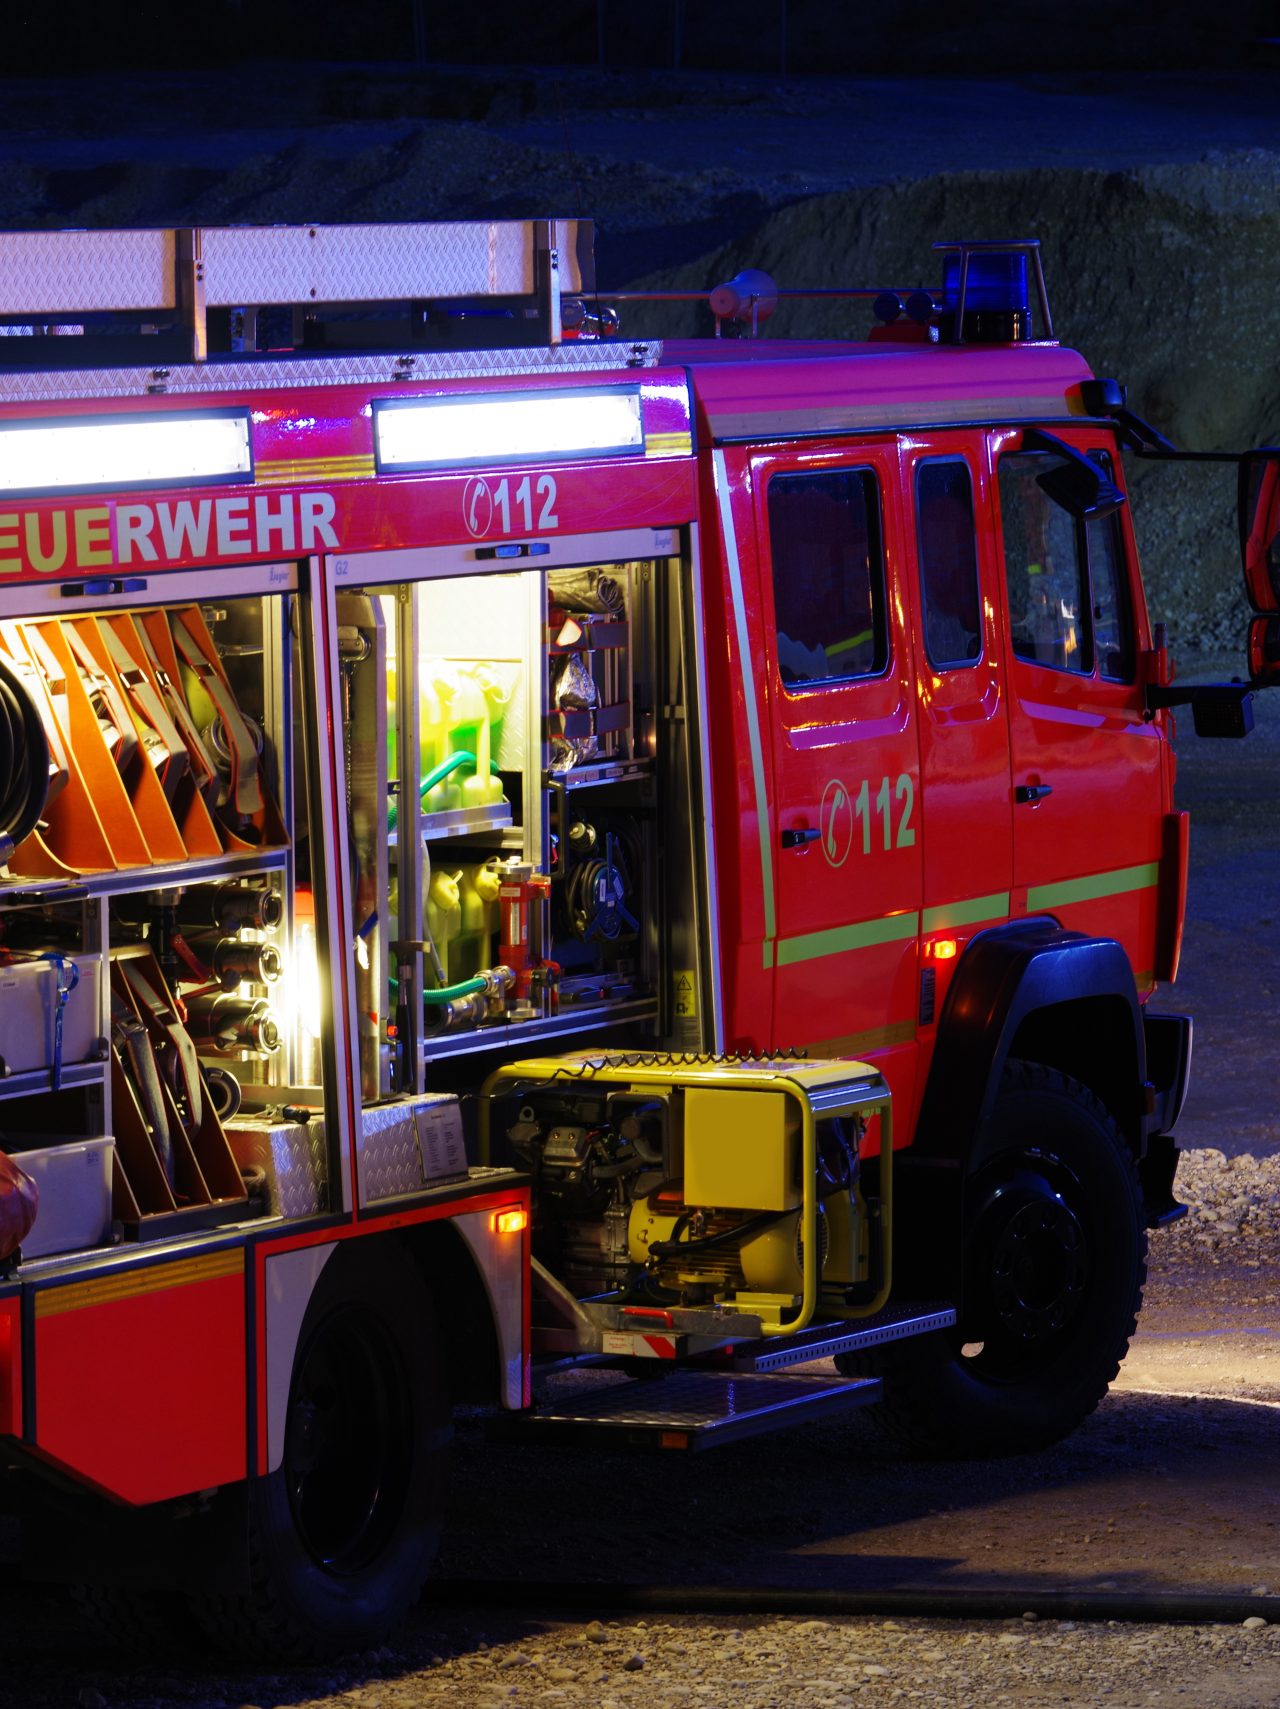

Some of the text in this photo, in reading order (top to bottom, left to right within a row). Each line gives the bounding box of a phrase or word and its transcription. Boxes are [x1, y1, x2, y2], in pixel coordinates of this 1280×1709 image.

[494, 475, 559, 534] 112
[335, 560, 349, 576] G2
[855, 773, 916, 855] 112
